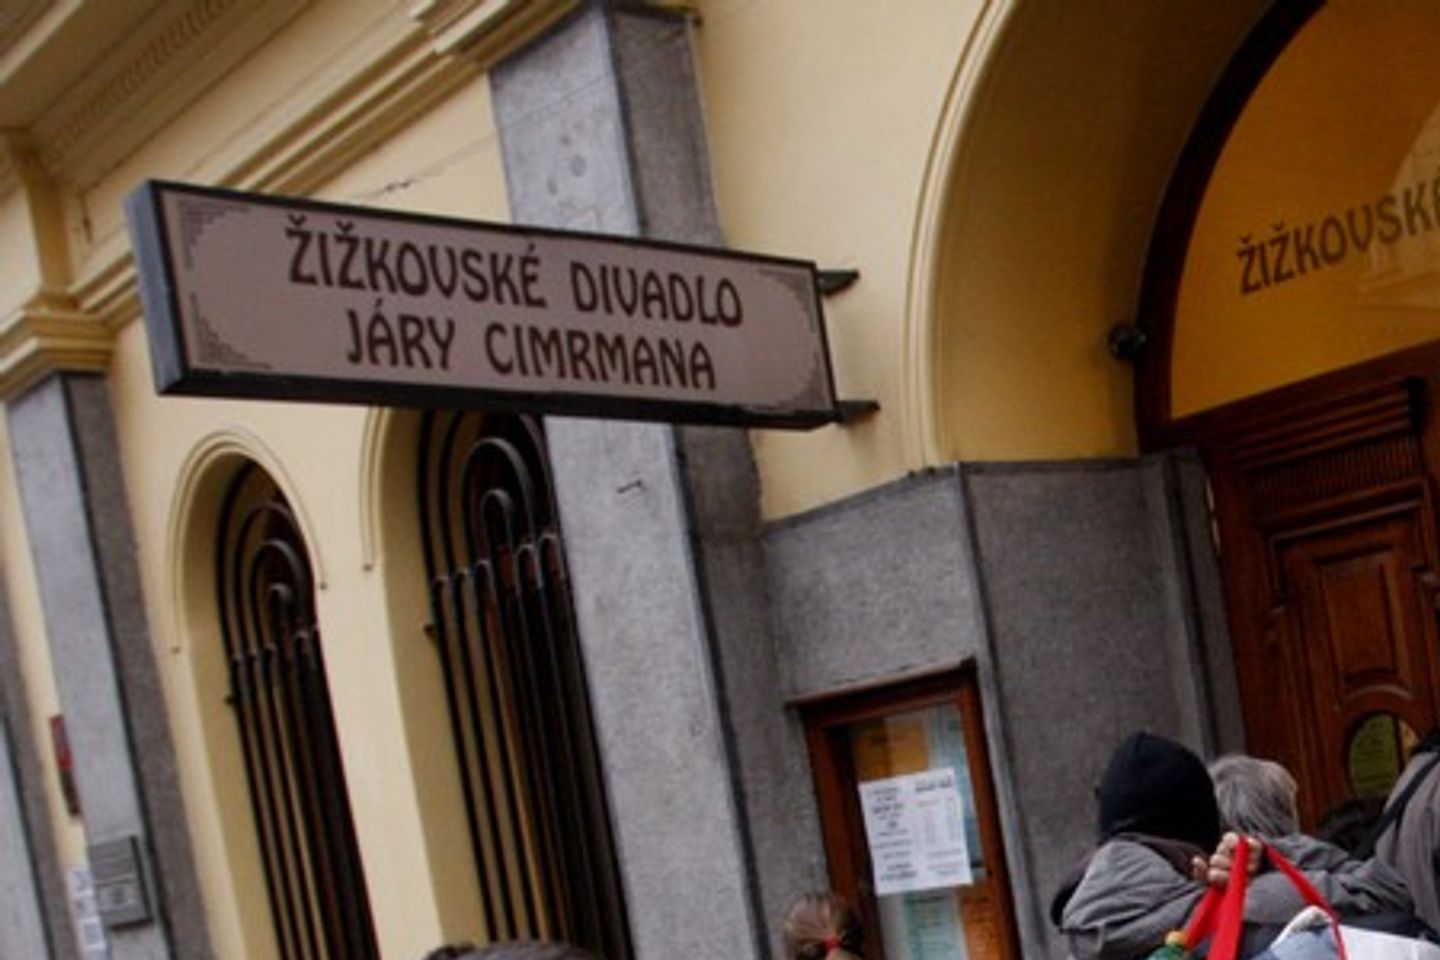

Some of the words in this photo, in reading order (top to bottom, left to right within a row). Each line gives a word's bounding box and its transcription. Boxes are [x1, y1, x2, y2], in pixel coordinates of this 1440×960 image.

[286, 213, 543, 305] ŽIŽKOVSKÉ
[572, 265, 744, 328] DIVADLO
[345, 298, 457, 371] JÁRY
[483, 322, 718, 391] CIMRMANA
